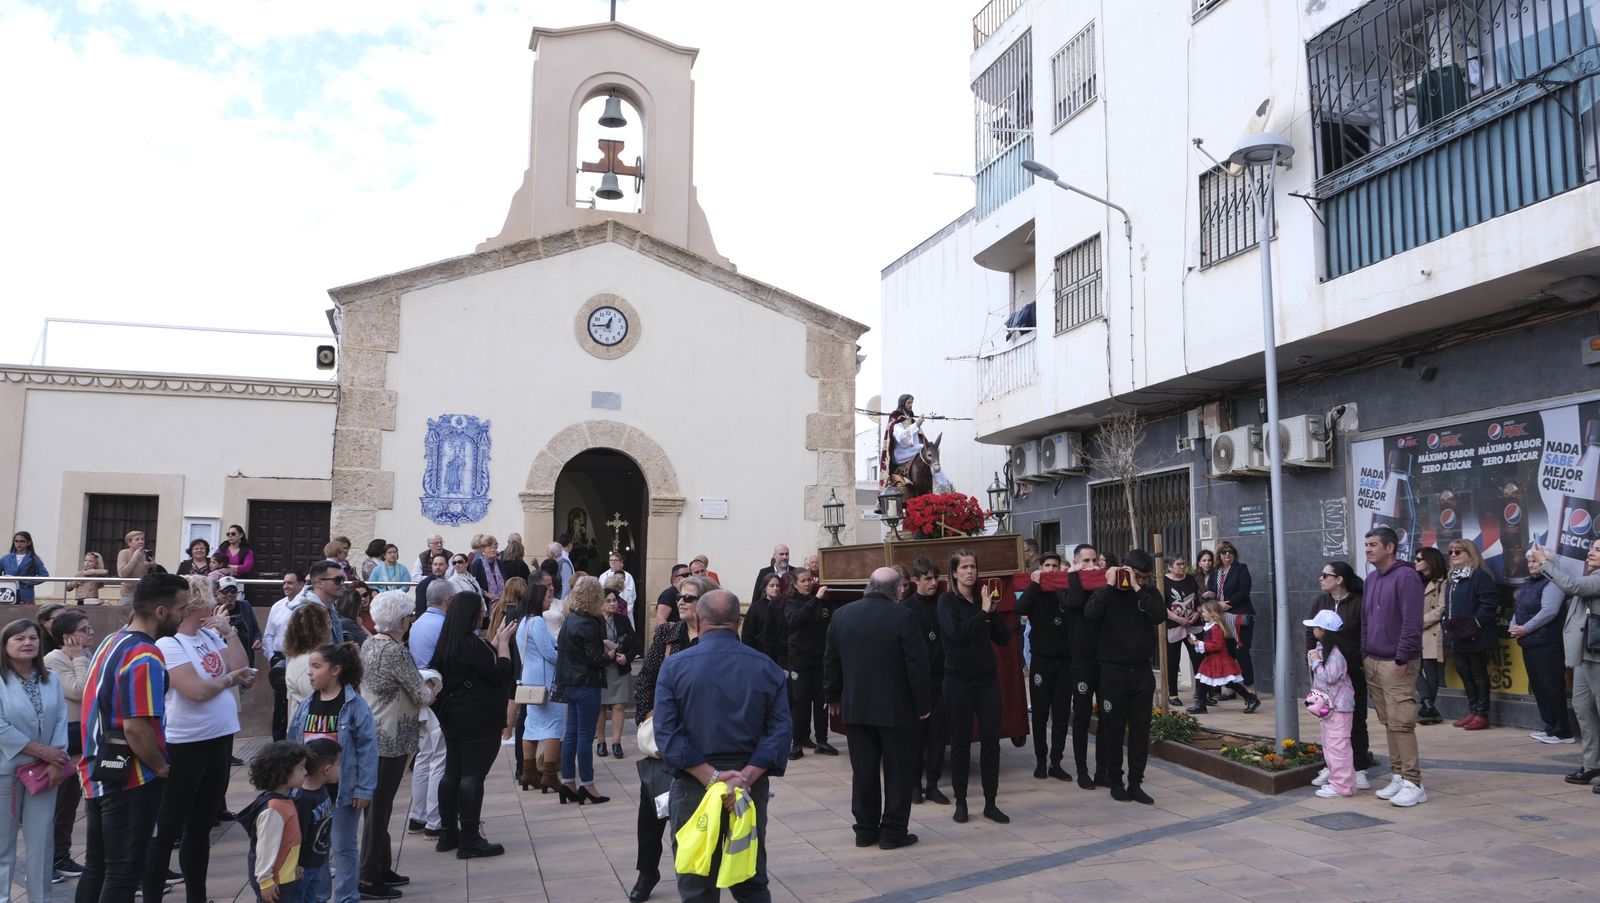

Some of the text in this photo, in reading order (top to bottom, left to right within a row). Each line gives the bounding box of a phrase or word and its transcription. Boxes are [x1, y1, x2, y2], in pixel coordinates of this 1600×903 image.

[1478, 438, 1541, 455] MÁXIMO SABOR
[1546, 441, 1579, 455] NADA
[1418, 448, 1475, 463] MÁXIMO SABOR
[1482, 450, 1538, 466] ZERO AZÚCAR
[1544, 453, 1574, 467] SABE
[1360, 467, 1384, 480] NADA
[1422, 459, 1472, 474] ZERO AZÚCAR
[1542, 465, 1583, 481] MEJOR
[1359, 477, 1380, 490] SABE
[1542, 478, 1575, 493] QUE...
[1358, 488, 1387, 502] MEJOR
[100, 760, 125, 769] PUMA
